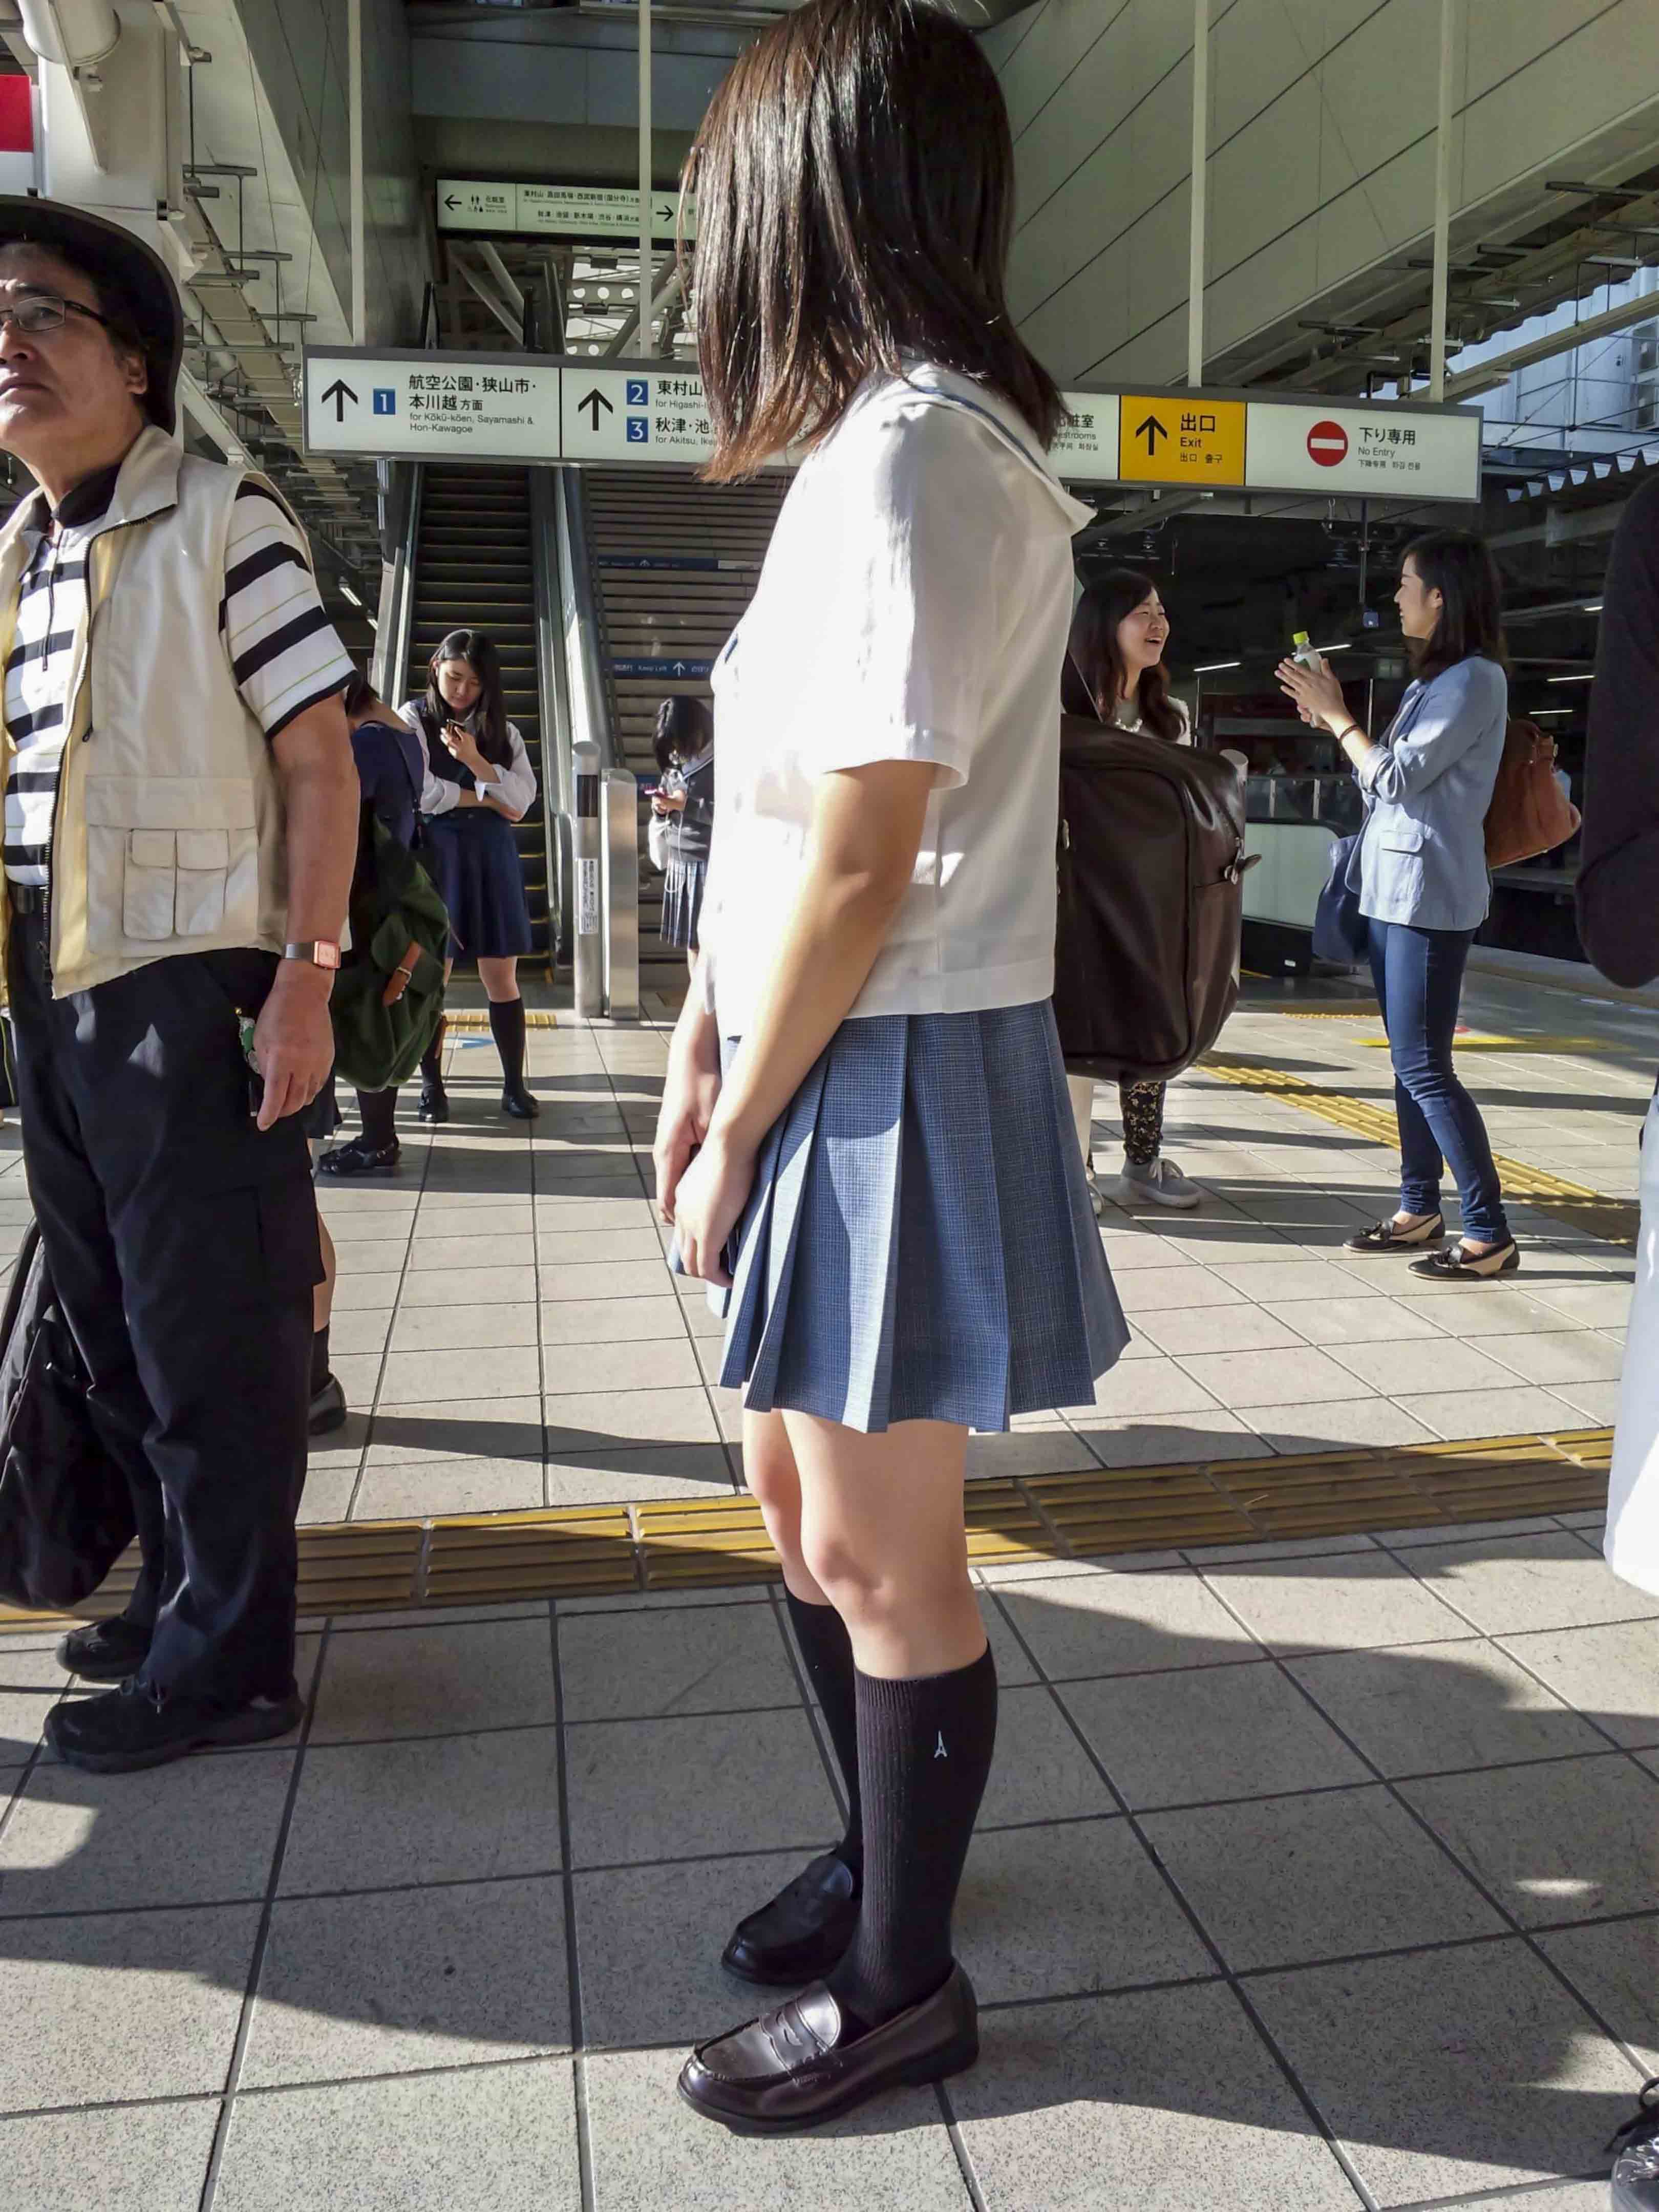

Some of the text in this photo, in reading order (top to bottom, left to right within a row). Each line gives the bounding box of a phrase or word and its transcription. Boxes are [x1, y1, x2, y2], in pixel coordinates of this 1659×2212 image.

[631, 385, 644, 403] 2
[380, 394, 387, 412] 1
[655, 399, 706, 410] for Higashi-
[410, 412, 421, 420] for
[527, 416, 533, 424] &
[1180, 412, 1216, 433] 出口
[410, 423, 473, 434] Hon-Kawagoe
[631, 421, 644, 440] 3
[1358, 427, 1416, 445] 下り専用
[1180, 437, 1202, 448] Exit
[1180, 452, 1197, 462] 出口
[1358, 446, 1395, 458] No Entry
